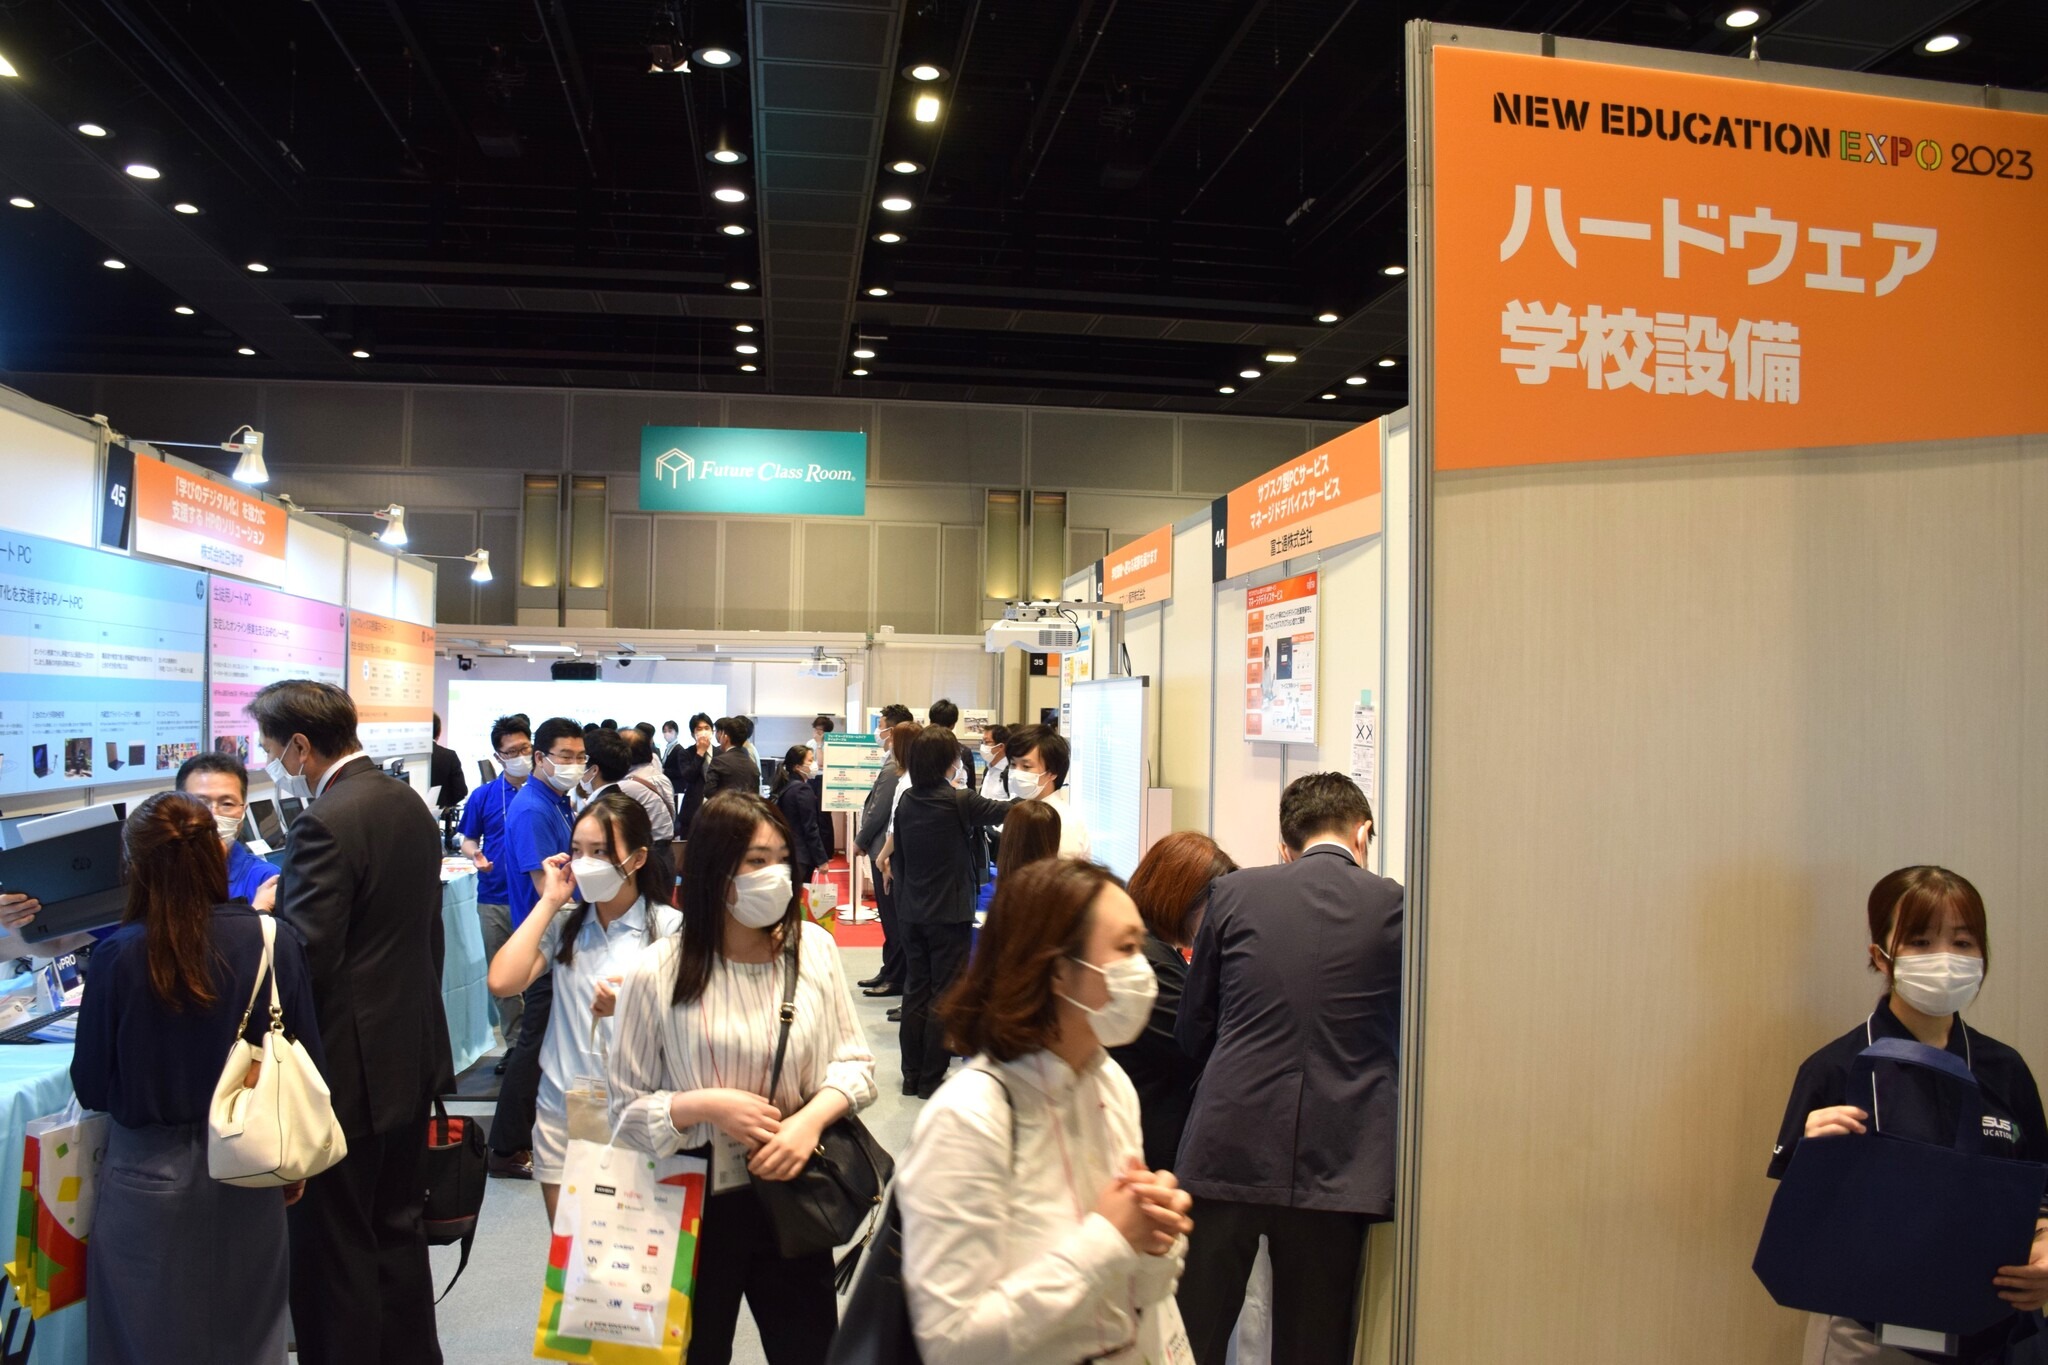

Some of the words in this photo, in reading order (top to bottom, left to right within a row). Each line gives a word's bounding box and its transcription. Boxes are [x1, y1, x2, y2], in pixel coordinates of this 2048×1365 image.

[1493, 92, 1590, 132] NEW
[1601, 102, 1831, 159] EDUCATION
[1839, 130, 1943, 171] EXPO
[1951, 143, 2034, 181] 2023
[1500, 184, 1938, 297] ハードウェア
[1500, 299, 1802, 405] 学校設備
[111, 483, 127, 508] 45
[699, 461, 754, 480] Future
[757, 462, 803, 481] Class
[1257, 454, 1330, 503] サブスク型PCサービス
[1250, 477, 1341, 530] マネージドデバイスサービス
[1215, 528, 1225, 548] 44
